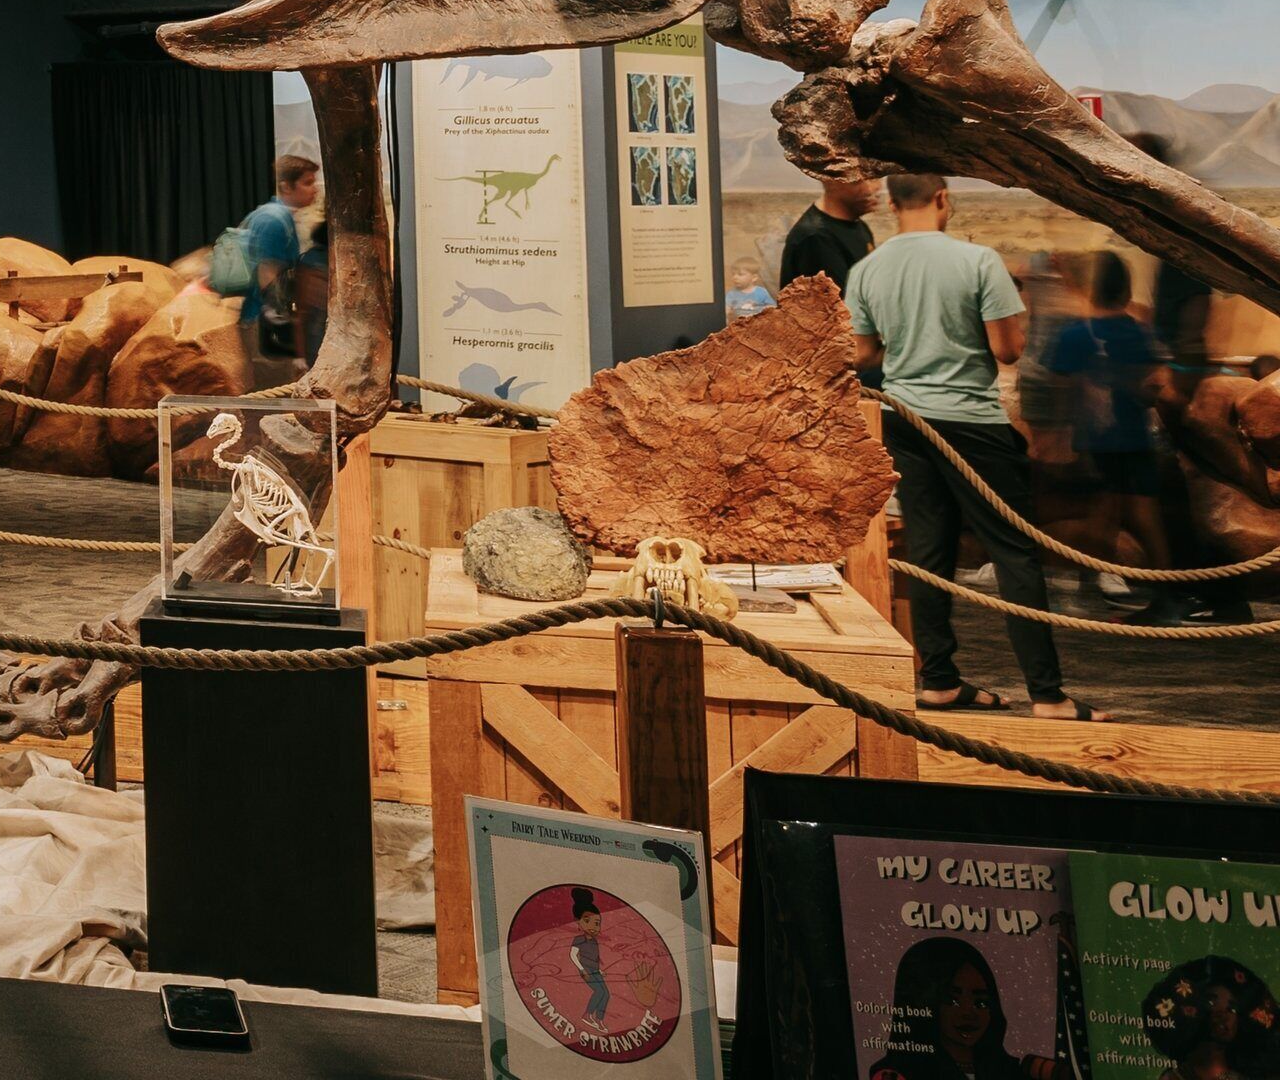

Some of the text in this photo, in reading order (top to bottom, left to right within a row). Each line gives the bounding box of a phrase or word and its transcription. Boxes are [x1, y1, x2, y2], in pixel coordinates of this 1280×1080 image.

[655, 33, 673, 47] ARE
[453, 115, 539, 126] Gillicus arcuatus
[444, 128, 460, 136] Prey
[444, 244, 557, 257] Struthiomimus sedens
[475, 258, 500, 267] Height
[511, 259, 526, 267] Hip
[452, 336, 555, 352] Hesperornis gracilis
[938, 857, 1054, 891] CAREER
[1109, 881, 1280, 928] GLOW U
[901, 901, 1040, 935] GLOW UP
[1082, 951, 1171, 972] Activity page
[530, 987, 576, 1039] SUMER
[856, 1001, 933, 1017] Coloring book
[1089, 1009, 1176, 1029] Coloring book
[862, 1037, 935, 1054] affirmations
[1096, 1051, 1178, 1069] affirmations
